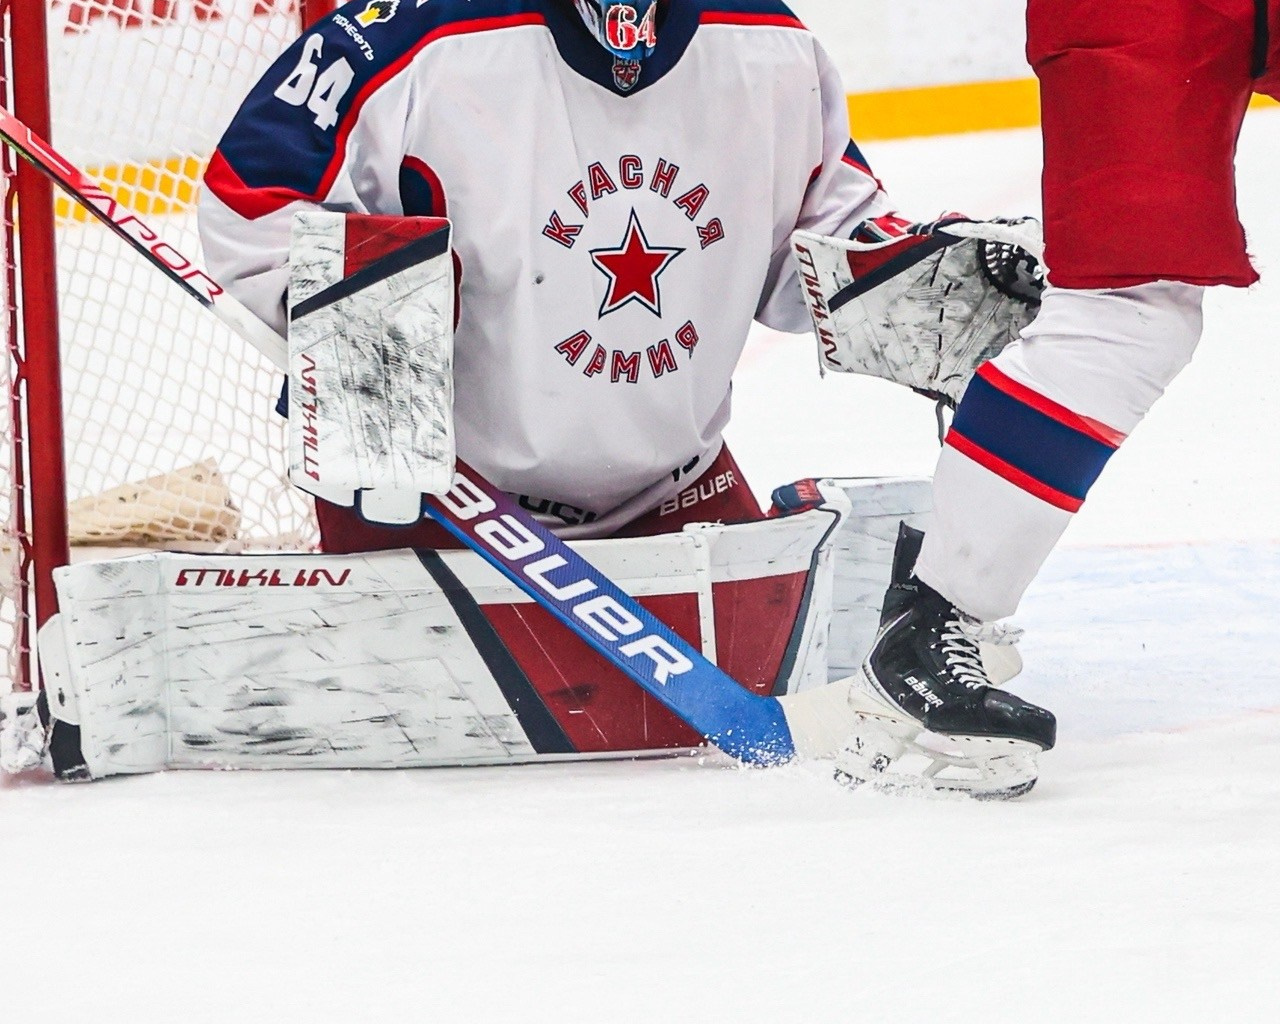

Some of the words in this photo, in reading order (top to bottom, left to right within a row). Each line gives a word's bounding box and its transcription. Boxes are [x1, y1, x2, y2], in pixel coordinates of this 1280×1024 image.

[605, 4, 657, 50] 64
[273, 32, 356, 132] 64
[541, 154, 725, 250] КРАСНАЯ
[554, 319, 700, 384] АРМИЯ
[175, 568, 351, 587] MIKLIN
